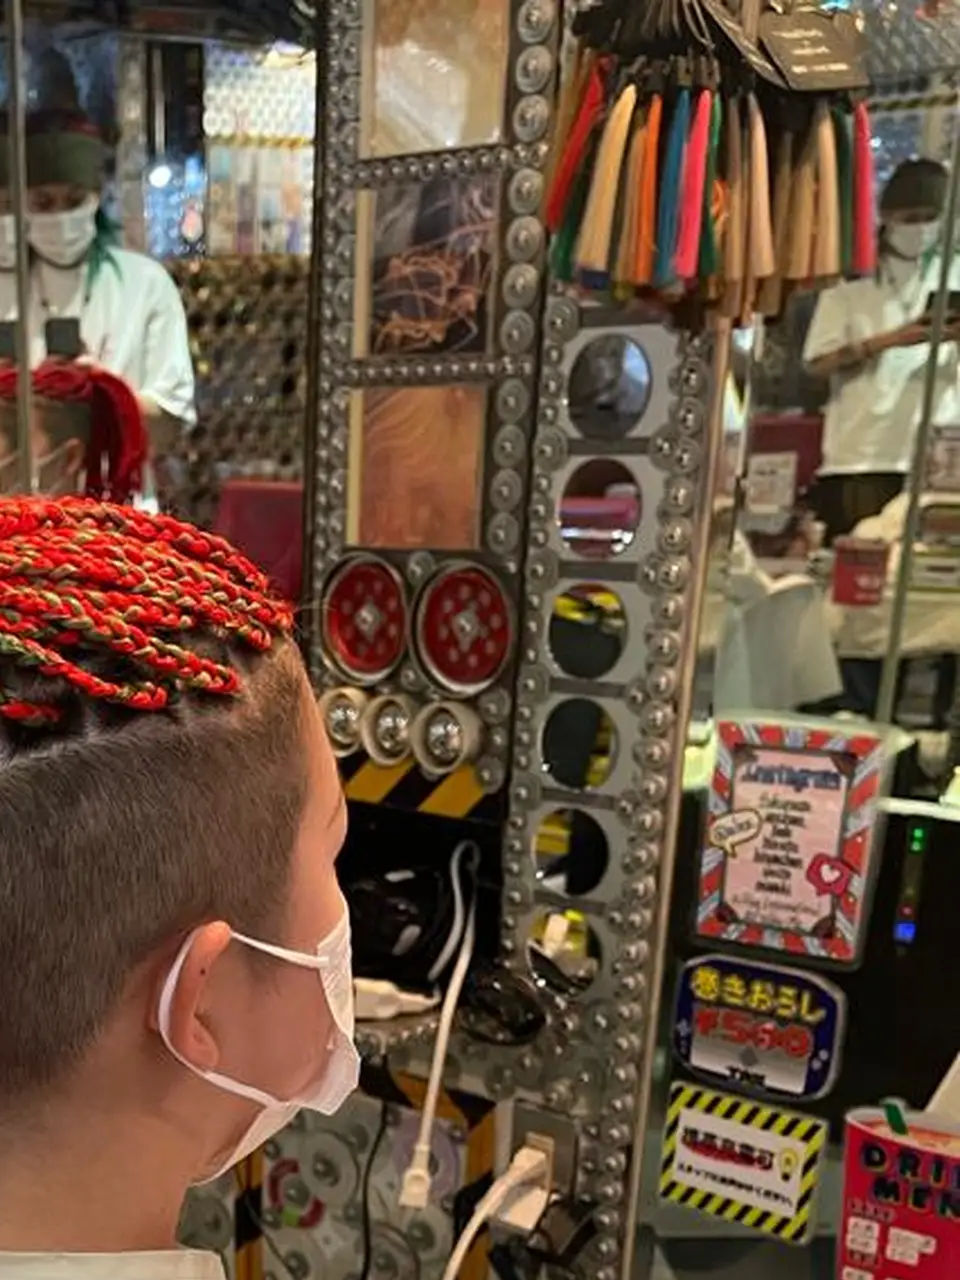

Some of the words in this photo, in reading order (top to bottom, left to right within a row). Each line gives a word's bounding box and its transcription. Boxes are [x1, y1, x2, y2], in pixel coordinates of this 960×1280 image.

[691, 966, 827, 1022] 巻きおろし
[860, 1143, 960, 1188] DRI
